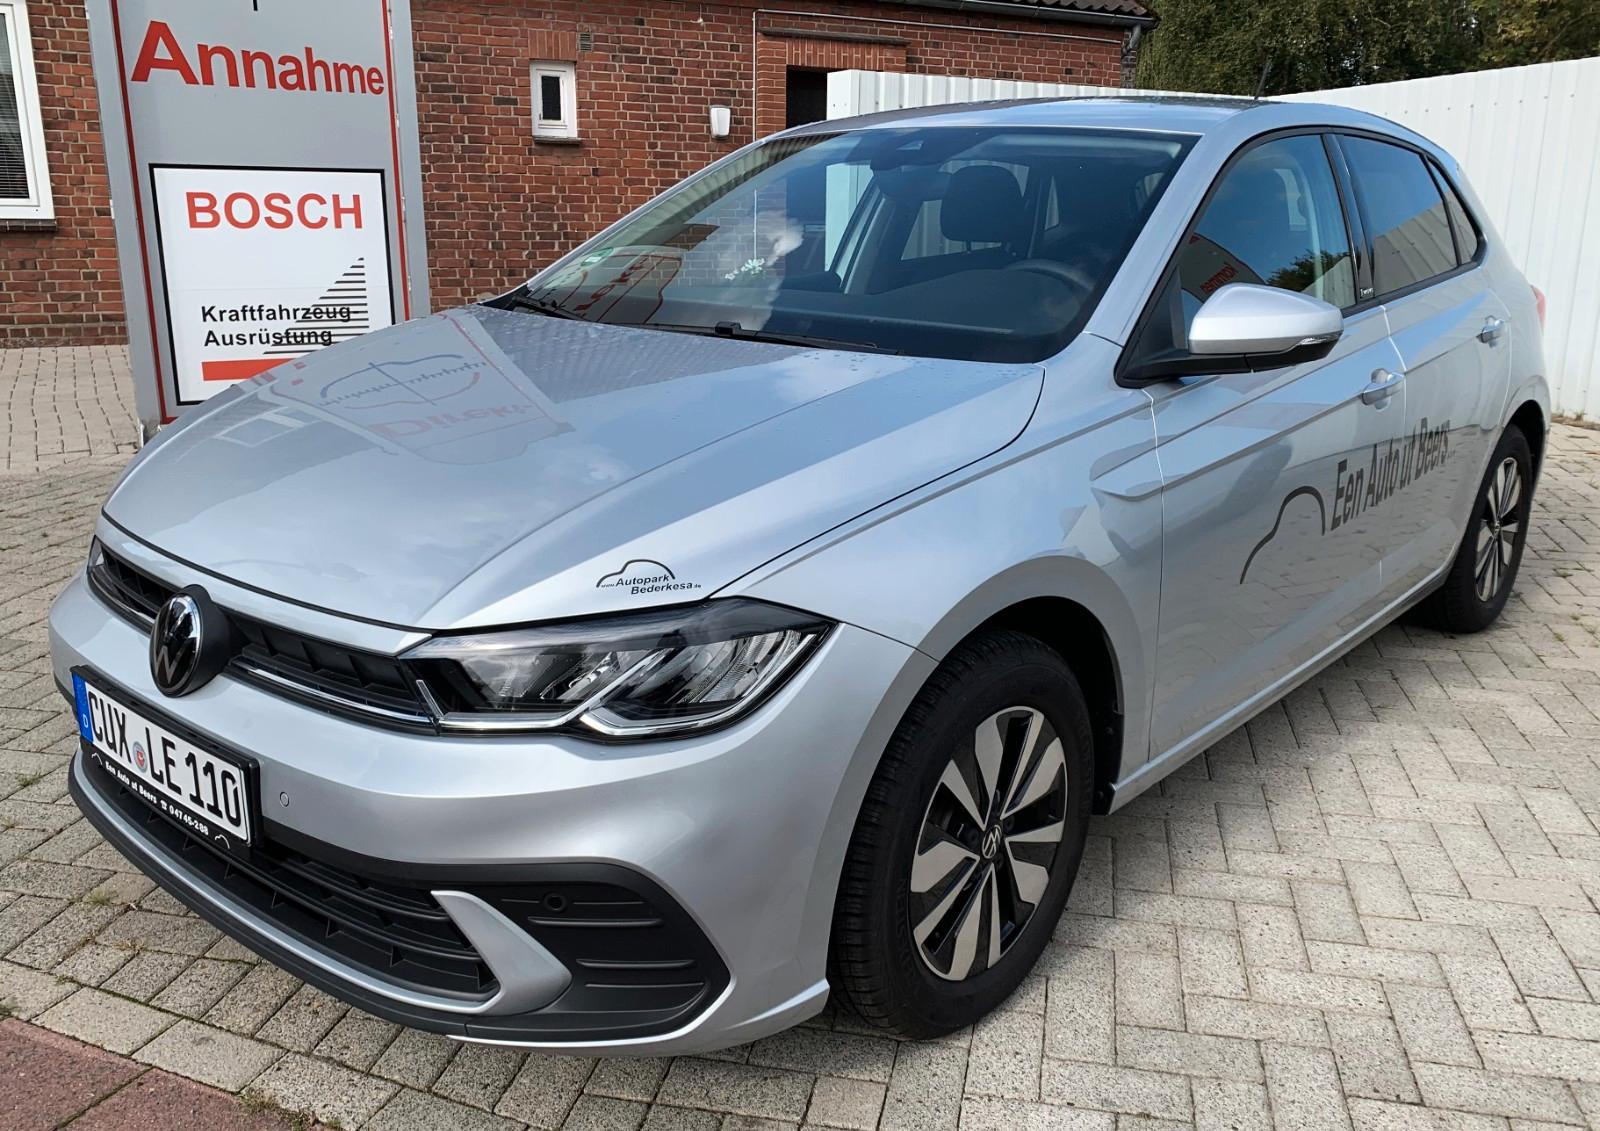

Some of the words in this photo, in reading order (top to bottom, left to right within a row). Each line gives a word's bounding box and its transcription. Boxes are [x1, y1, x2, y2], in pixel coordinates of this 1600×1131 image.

[131, 20, 385, 95] Annahme
[185, 191, 363, 230] BOSCH
[204, 328, 332, 347] Ausrüstung
[1331, 458, 1365, 531] Een
[1363, 437, 1400, 512] Auto
[1415, 417, 1451, 480] Beers
[88, 691, 132, 764] CUX
[145, 727, 182, 796] LE
[185, 752, 242, 828] 110
